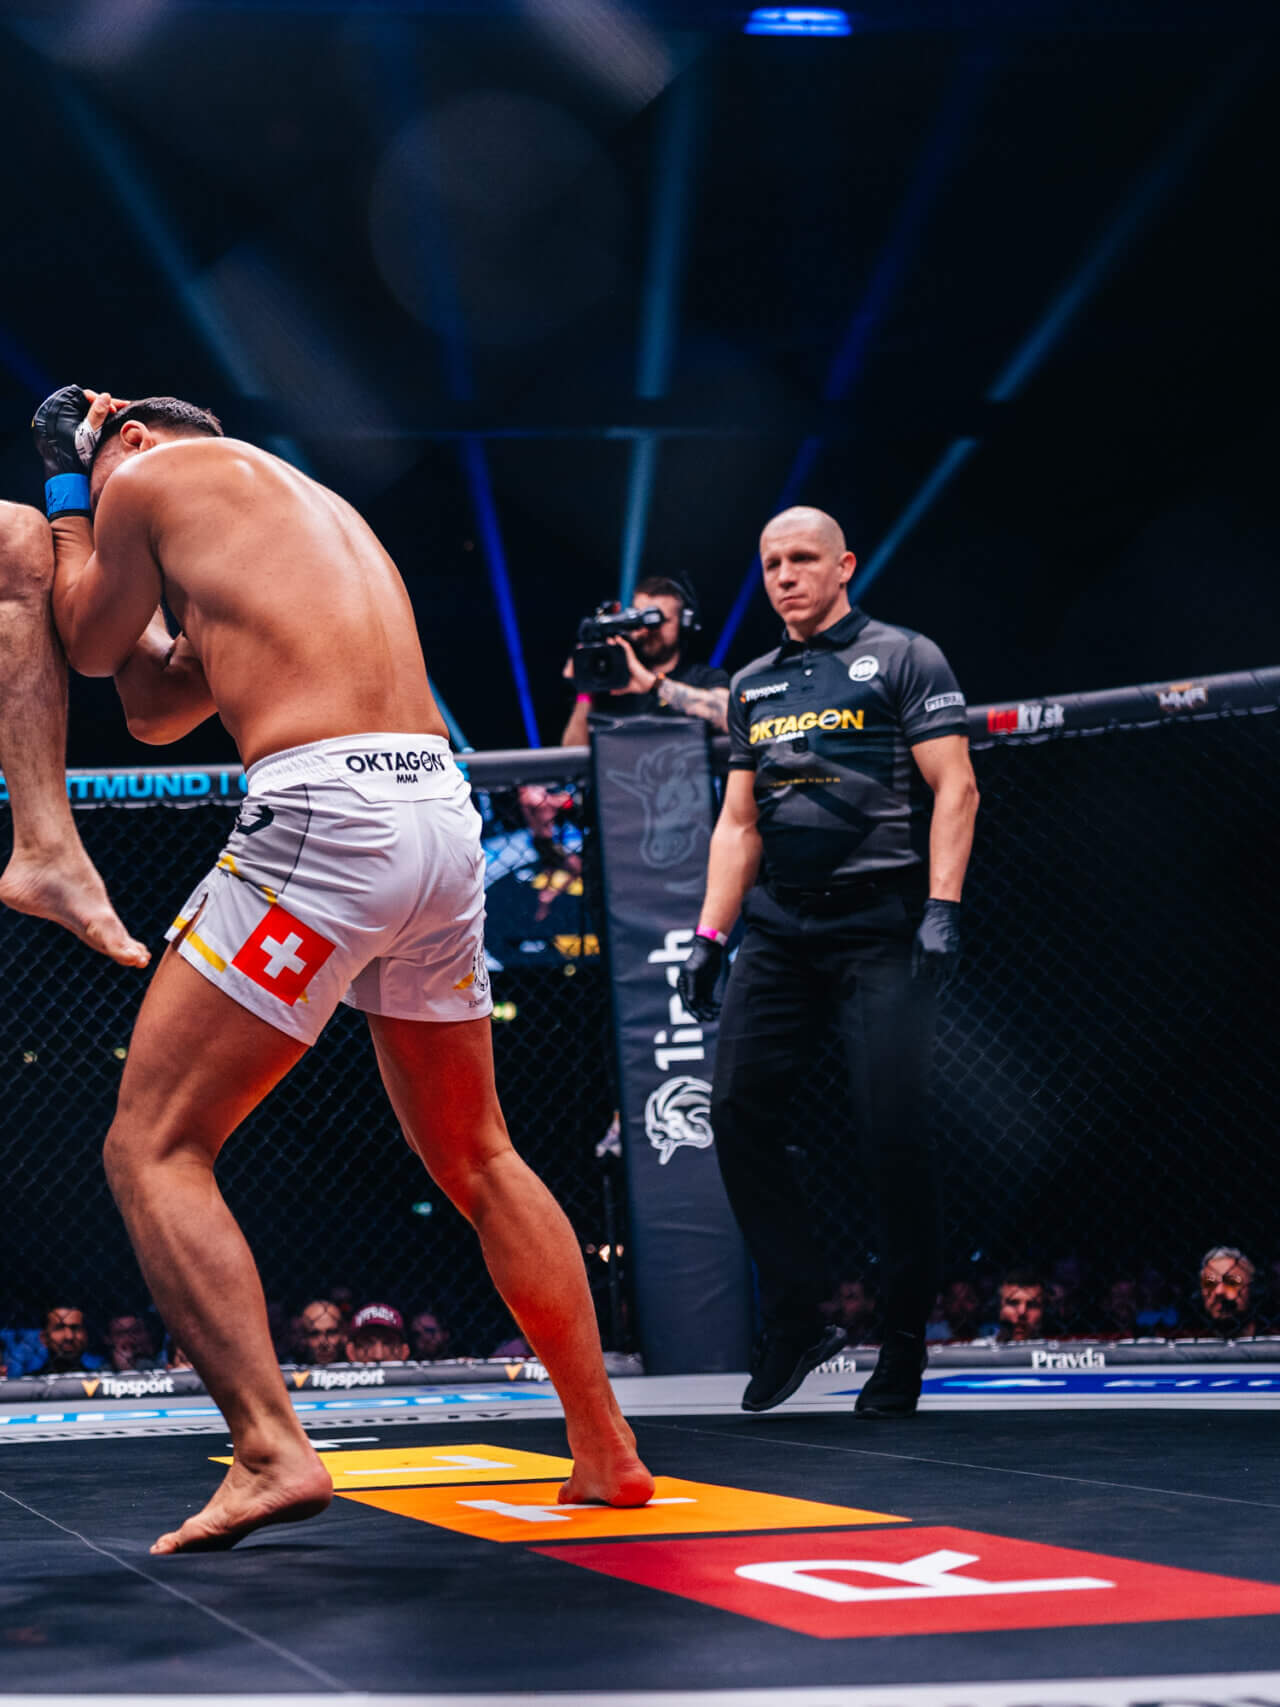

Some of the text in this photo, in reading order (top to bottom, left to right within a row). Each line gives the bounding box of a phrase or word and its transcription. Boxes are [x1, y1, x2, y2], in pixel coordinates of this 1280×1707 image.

[749, 709, 865, 744] OKTAGON
[346, 750, 446, 773] OKTAGON
[396, 774, 419, 784] MMA
[1032, 1348, 1106, 1370] Pravda
[102, 1377, 175, 1399] Tipsport
[312, 1368, 386, 1390] Tipsport
